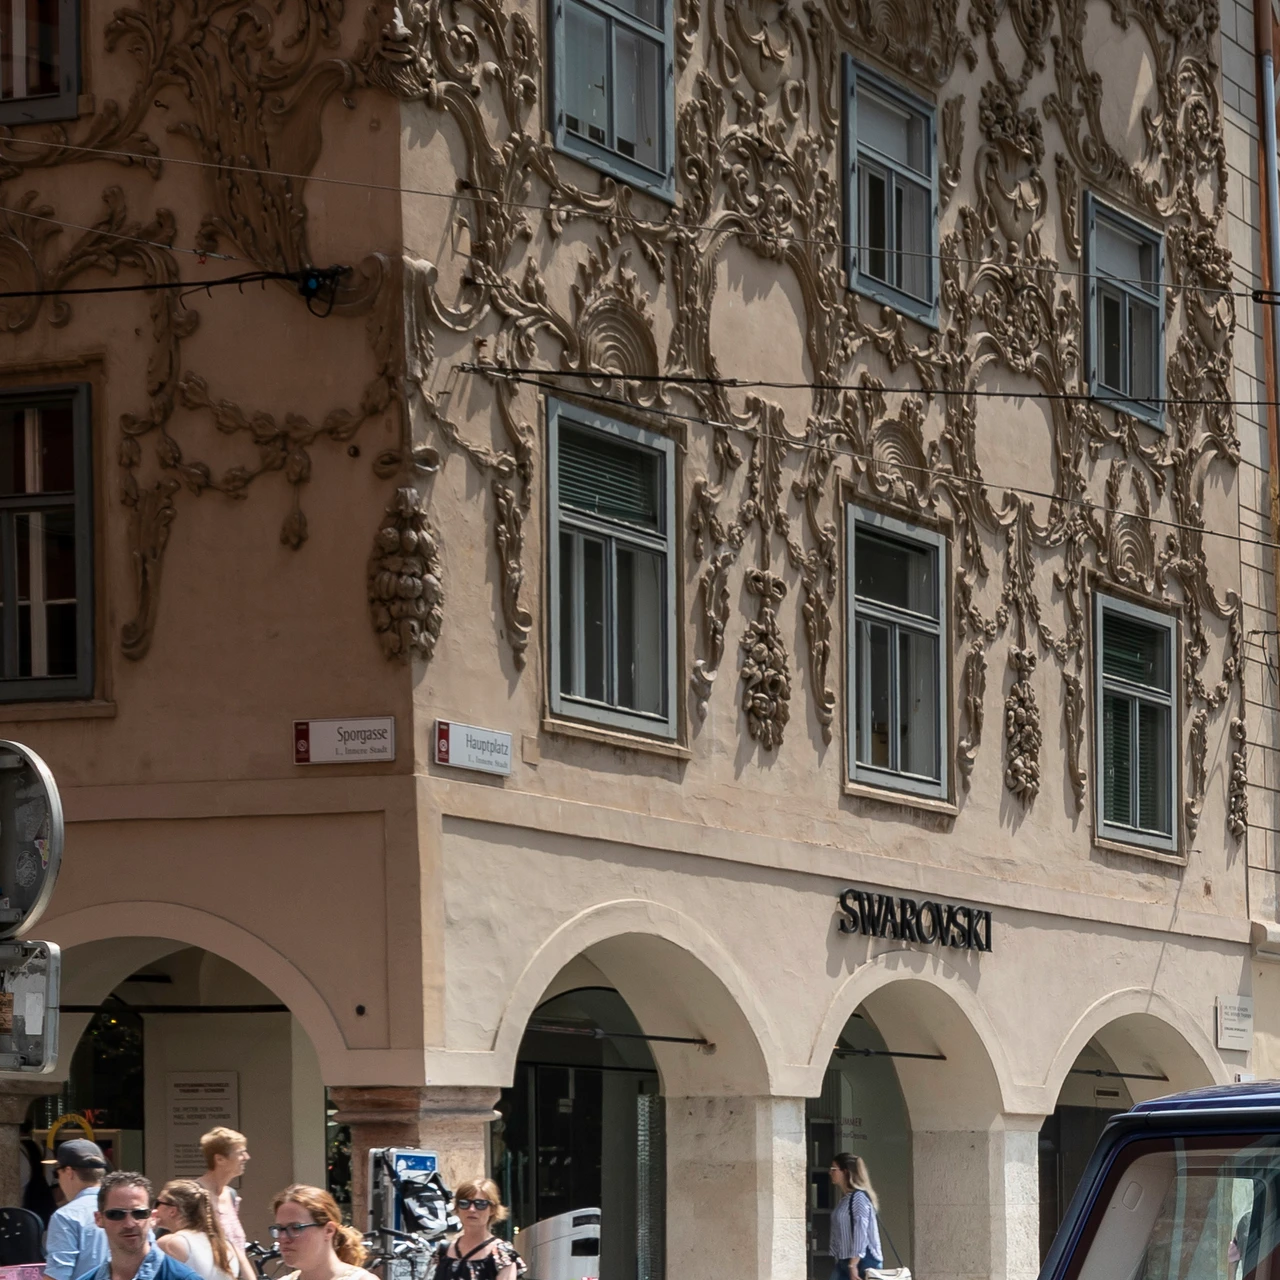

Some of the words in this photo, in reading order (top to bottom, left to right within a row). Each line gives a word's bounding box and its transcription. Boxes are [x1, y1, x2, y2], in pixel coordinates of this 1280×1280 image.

[337, 727, 388, 745] Sporgasse
[466, 734, 508, 756] Hauptplatz
[476, 756, 493, 765] Innere
[495, 760, 508, 769] Stadt
[839, 888, 992, 952] SWAROVSKI
